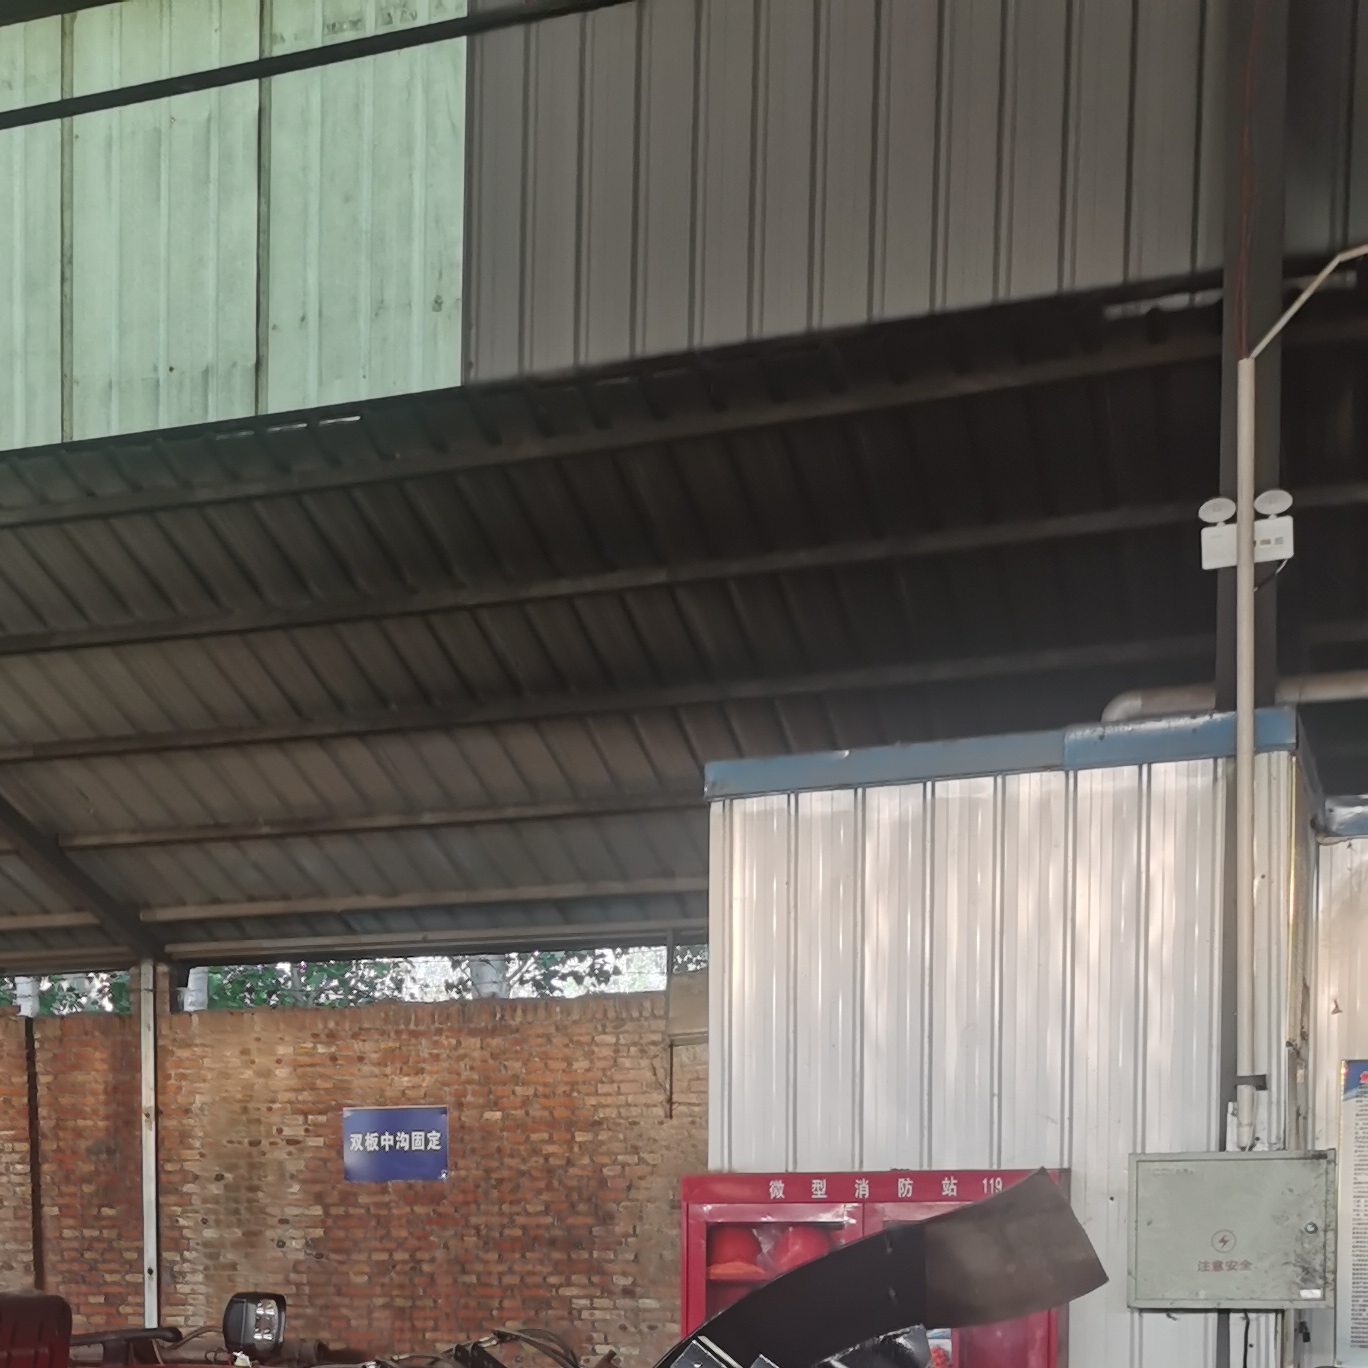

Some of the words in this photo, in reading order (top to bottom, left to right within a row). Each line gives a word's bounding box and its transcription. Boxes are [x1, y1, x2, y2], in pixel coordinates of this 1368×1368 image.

[349, 1131, 442, 1152] 双板中沟固定
[768, 1177, 958, 1199] 微型消防站
[982, 1177, 1003, 1194] 119
[1197, 1258, 1253, 1272] 注意安全
